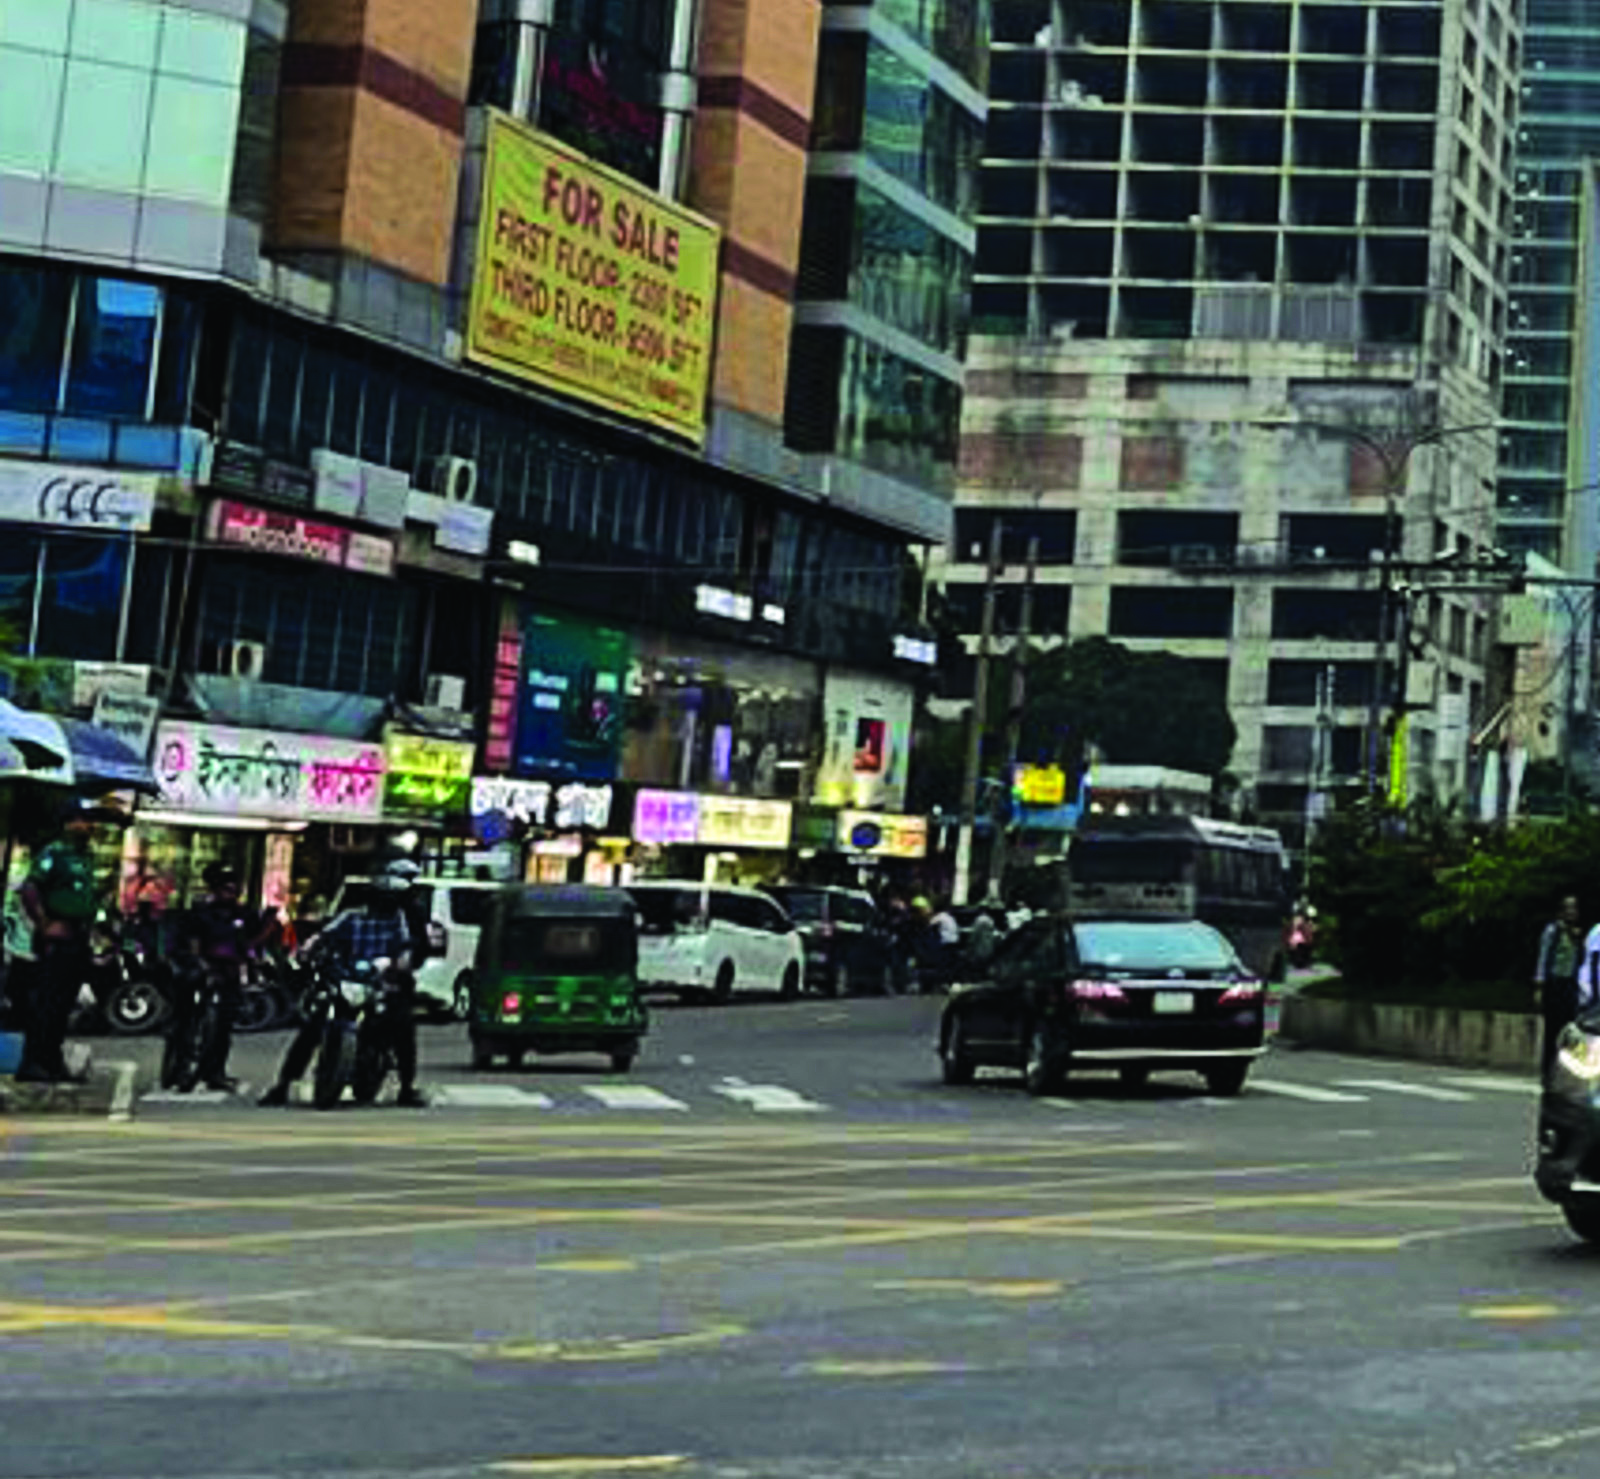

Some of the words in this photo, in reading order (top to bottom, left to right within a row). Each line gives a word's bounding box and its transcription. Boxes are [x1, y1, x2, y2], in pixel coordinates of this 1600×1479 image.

[495, 207, 552, 266] FIRST
[543, 164, 603, 239] FOR
[612, 200, 680, 274] SALE
[492, 257, 549, 319] THIRD
